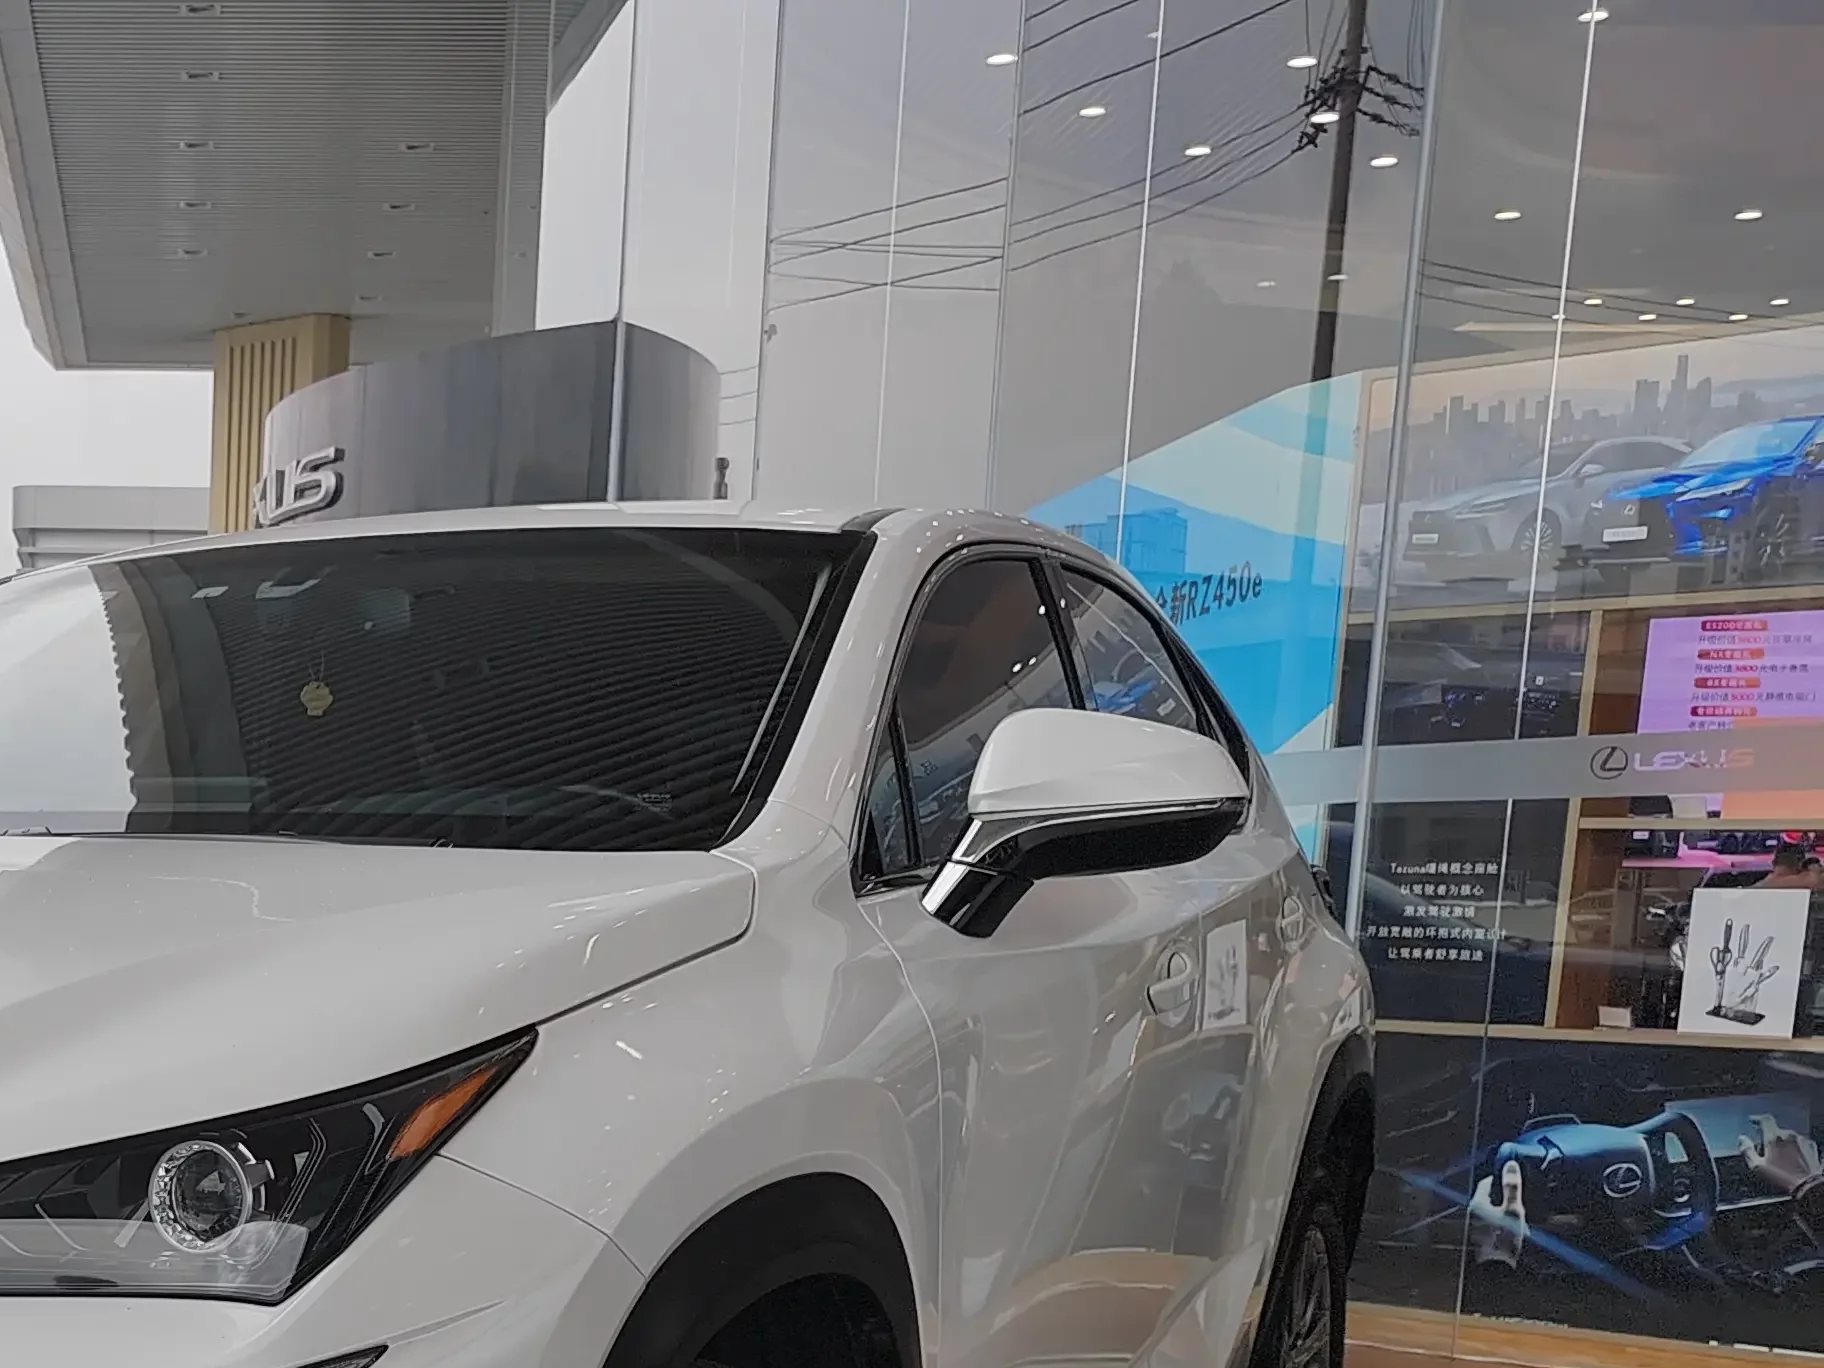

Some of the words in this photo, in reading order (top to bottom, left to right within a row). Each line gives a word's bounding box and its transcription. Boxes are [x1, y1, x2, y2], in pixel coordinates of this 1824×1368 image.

[1633, 748, 1756, 772] LEXUS
[1400, 884, 1485, 896] 以驾驶者为核心
